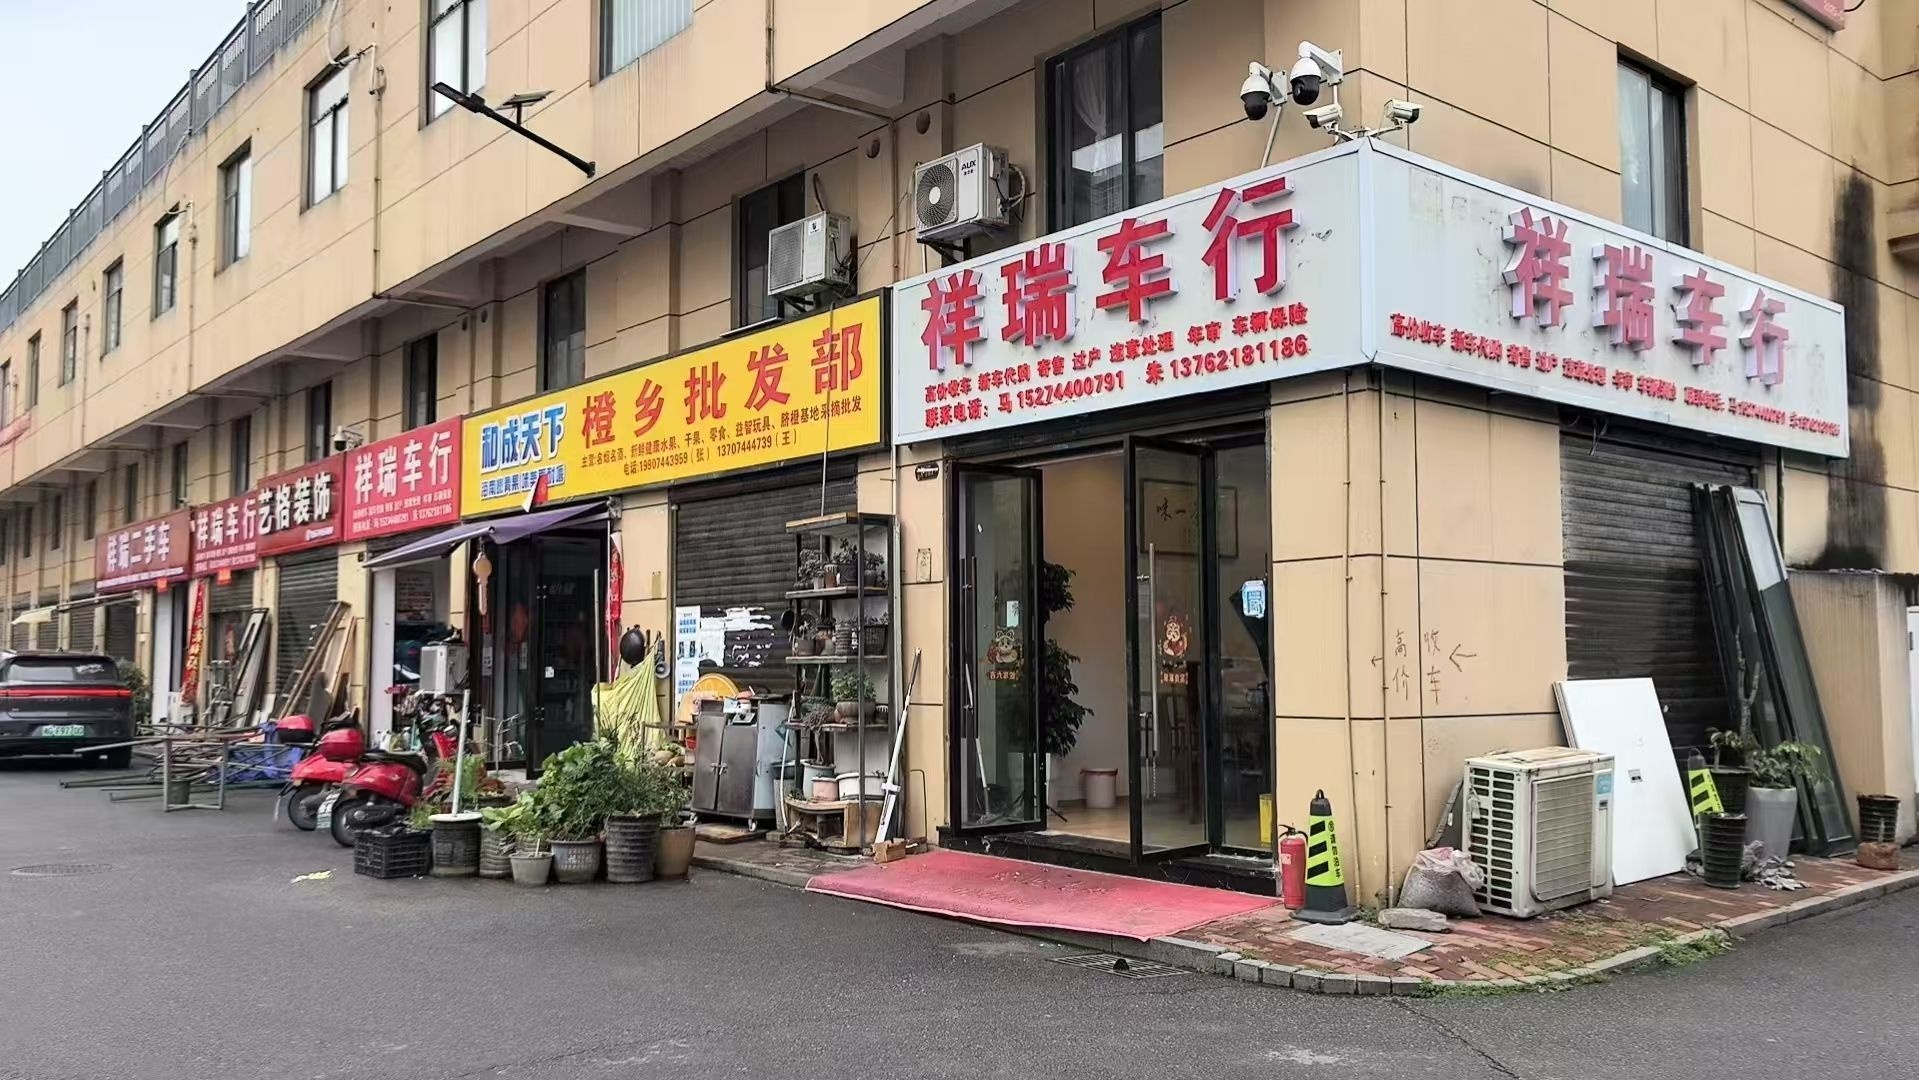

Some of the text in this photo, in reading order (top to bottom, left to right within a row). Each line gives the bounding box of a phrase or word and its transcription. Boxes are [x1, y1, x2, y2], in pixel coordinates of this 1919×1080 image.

[961, 159, 976, 170] AUX
[920, 176, 1300, 372] 祥瑞车行
[1502, 206, 1789, 386] 祥瑞车行
[924, 377, 972, 404] 高价收车
[978, 363, 1031, 392] 新车代购
[1037, 355, 1065, 378] 寄售
[1072, 347, 1101, 370] 过户
[1187, 321, 1222, 347] 年审
[1232, 302, 1309, 337] 车辆保险
[1390, 313, 1446, 348] 高价收车
[582, 322, 863, 449] 橙乡批发部
[998, 392, 1013, 413] 马
[1017, 370, 1125, 408] 15274400791
[1146, 359, 1164, 385] 朱
[1169, 334, 1309, 379] 13762181186
[354, 430, 453, 505] 祥瑞车行
[481, 403, 566, 473] 和成天下
[195, 498, 256, 550] 祥瑞车行
[258, 472, 332, 535] 艺格装饰
[106, 521, 171, 573] 祥瑞二手车
